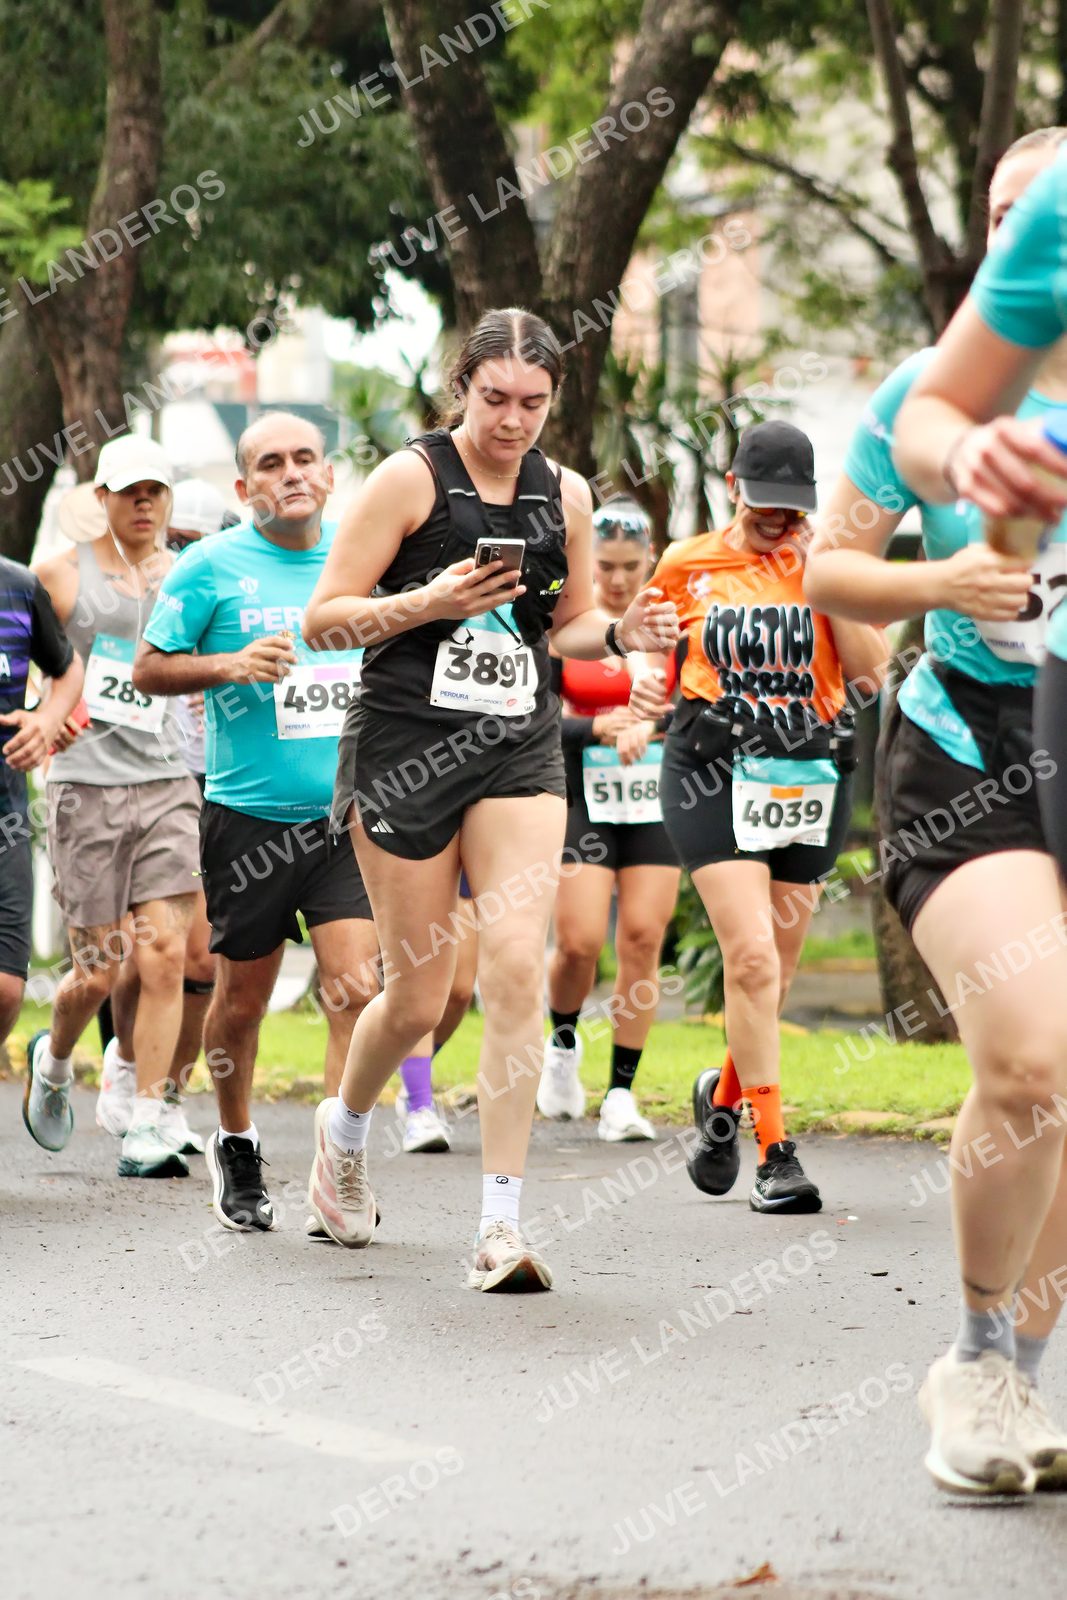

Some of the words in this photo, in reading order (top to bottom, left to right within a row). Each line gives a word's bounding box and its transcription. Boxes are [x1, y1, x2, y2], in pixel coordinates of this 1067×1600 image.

[239, 606, 306, 633] PER
[443, 646, 529, 688] 3897
[284, 681, 361, 713] 498
[440, 690, 469, 700] PERDURA
[593, 780, 659, 804] 5168
[742, 799, 823, 828] 4039
